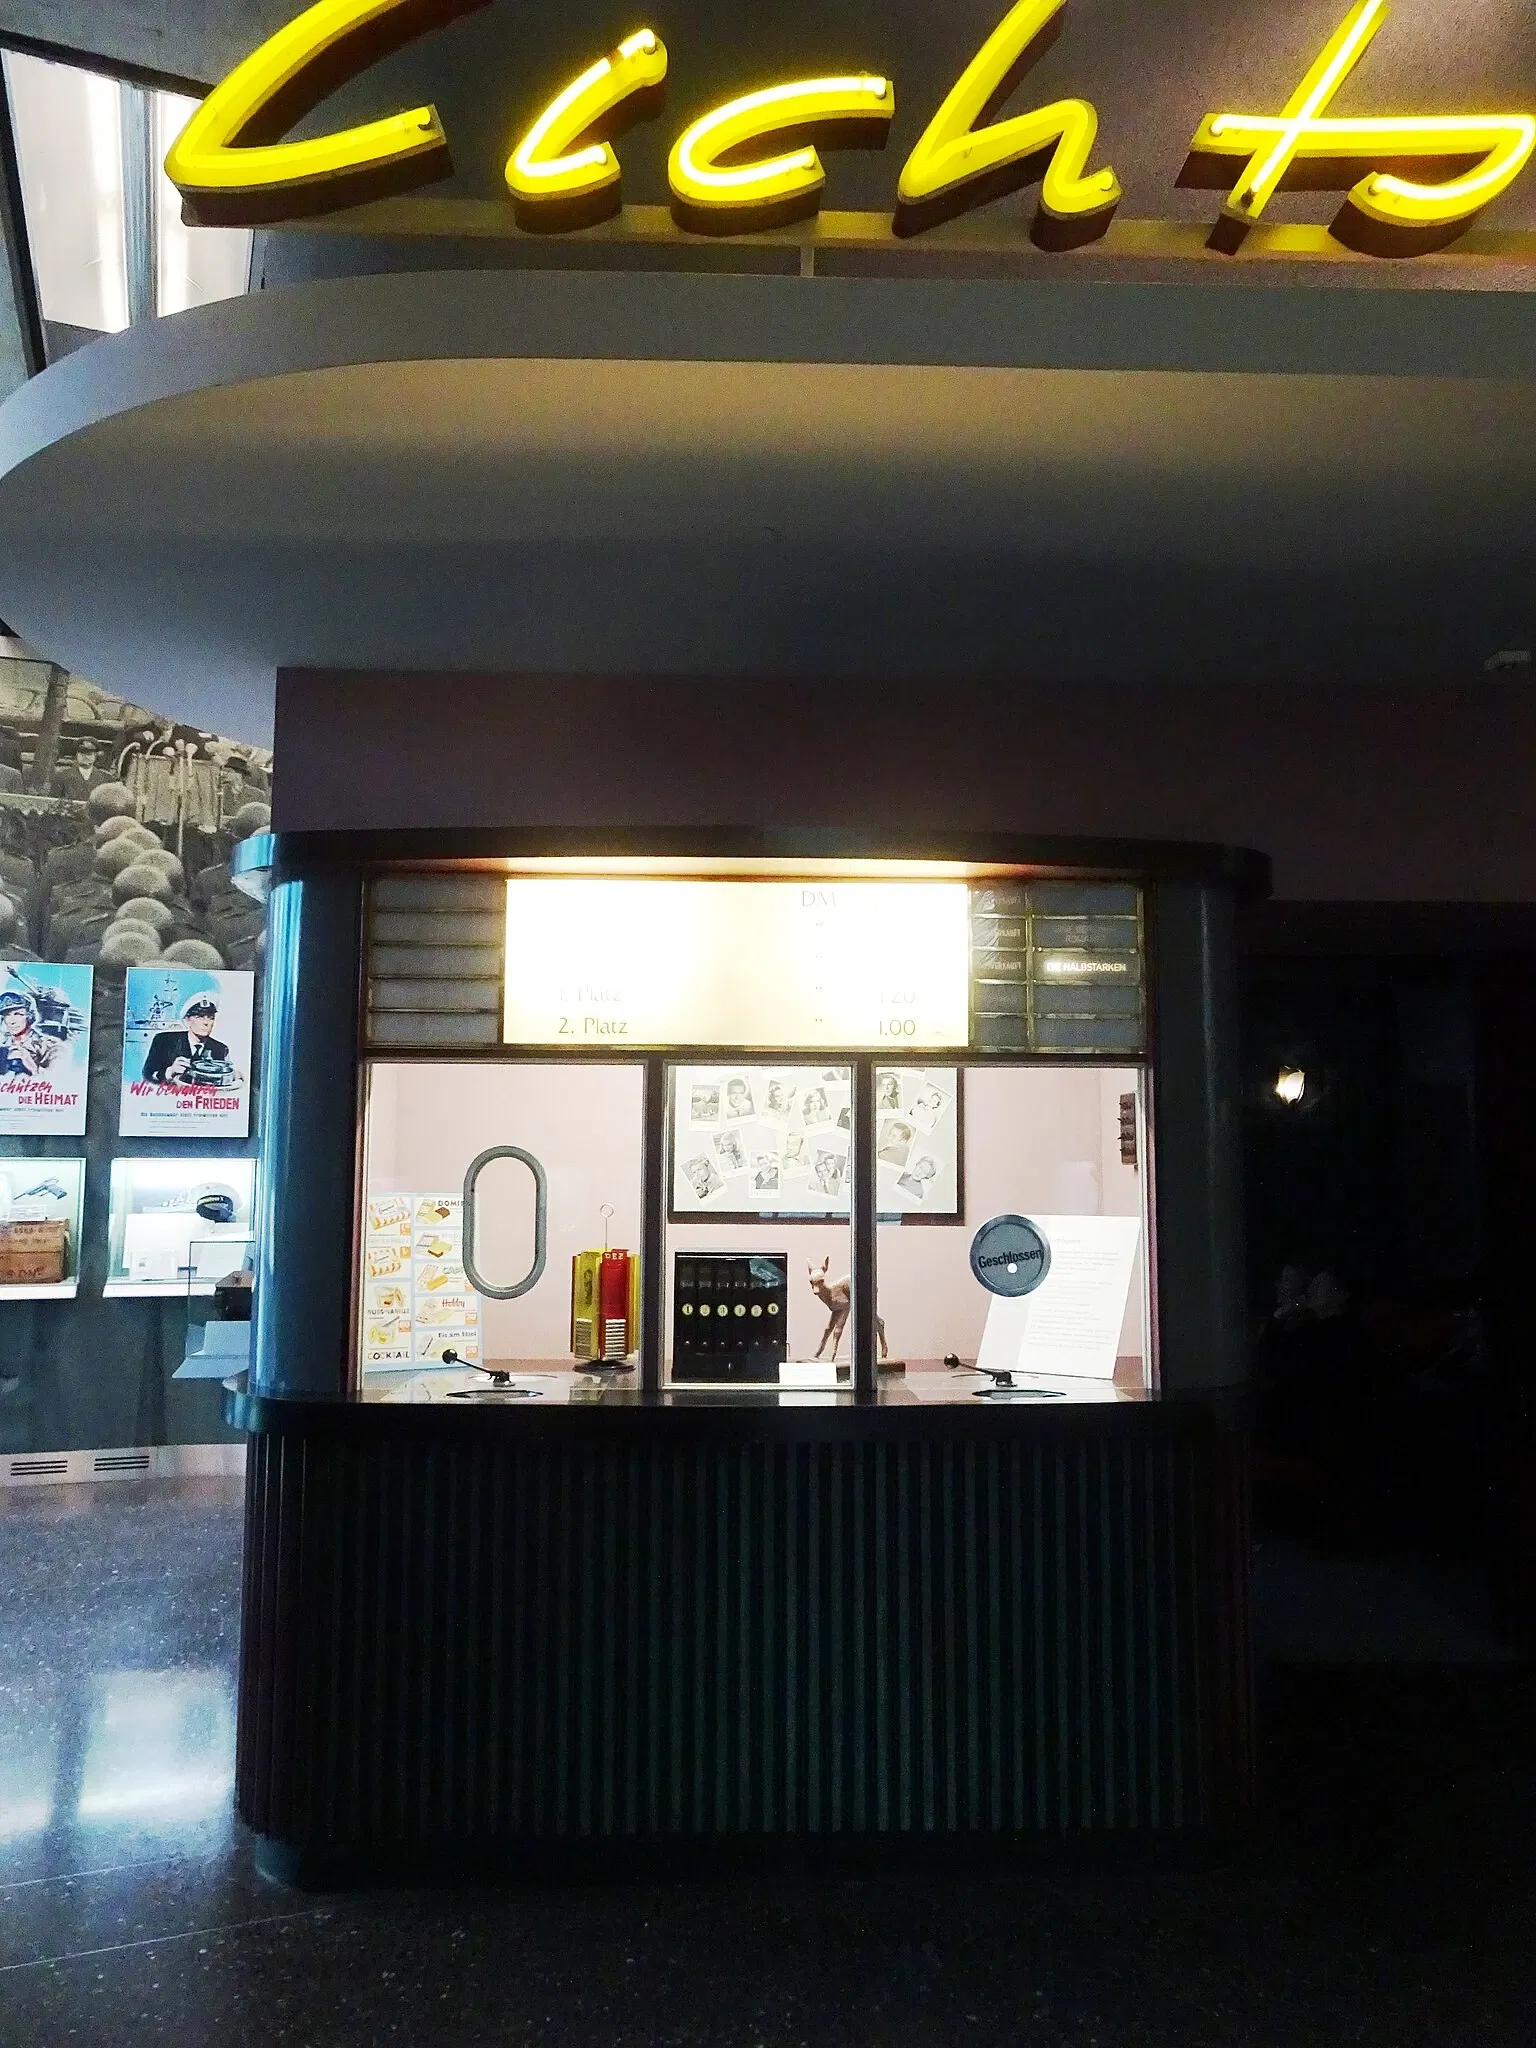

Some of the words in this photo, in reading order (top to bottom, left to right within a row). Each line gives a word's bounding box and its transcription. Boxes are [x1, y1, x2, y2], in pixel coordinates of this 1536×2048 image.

[1063, 962, 1127, 972] HALBSTARKEN
[558, 1016, 575, 1034] 2.
[584, 1016, 629, 1034] Platz
[879, 1020, 916, 1036] 1.00
[130, 1080, 154, 1096] Wir
[155, 1080, 218, 1097] bewahren
[18, 1095, 33, 1105] DIE
[35, 1092, 79, 1106] HEIMAT
[176, 1100, 193, 1109] DEN
[195, 1095, 240, 1110] FRIEDEN
[977, 1248, 1043, 1270] Geschlossen
[442, 1297, 465, 1308] Hobby
